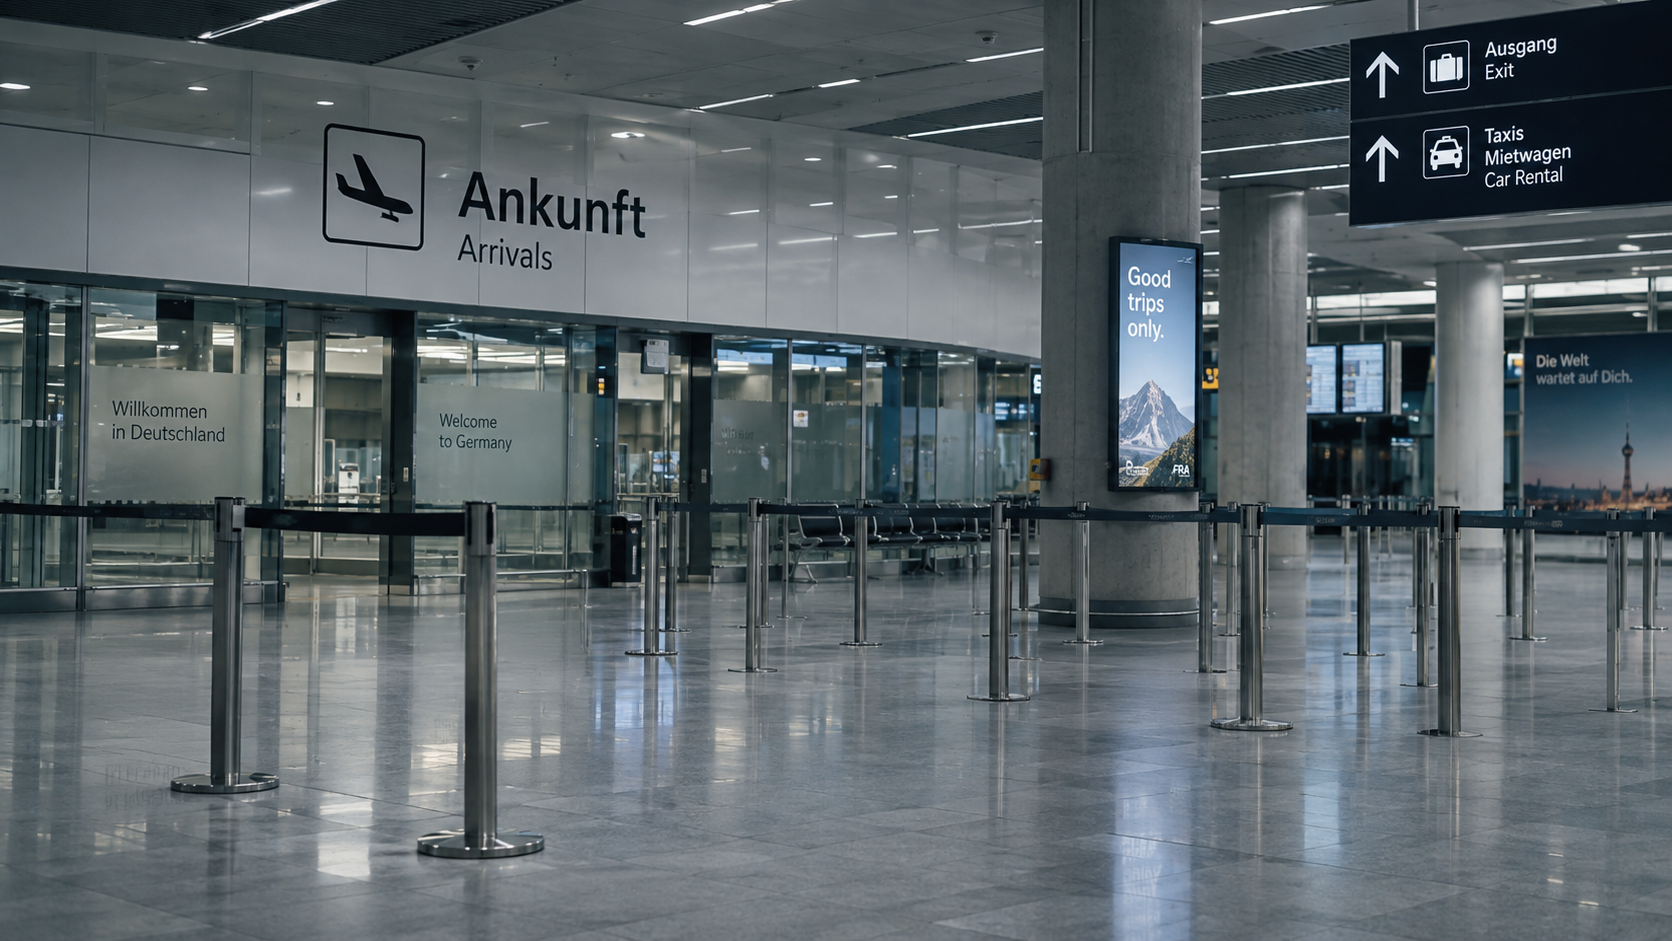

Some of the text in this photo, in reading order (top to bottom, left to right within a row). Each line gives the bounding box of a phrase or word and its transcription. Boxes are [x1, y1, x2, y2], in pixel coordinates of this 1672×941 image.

[1484, 37, 1557, 58] Ausgang
[1484, 63, 1515, 80] Exit
[1484, 126, 1524, 144] Taxis
[1484, 145, 1572, 167] Mietwagen
[1484, 166, 1563, 188] Car Rental
[458, 171, 646, 238] Ankunft
[457, 234, 553, 271] Arrivals
[1127, 266, 1171, 289] Good
[1127, 292, 1165, 316] trips
[1127, 319, 1165, 343] only.
[1536, 353, 1590, 368] Die Welt
[1536, 369, 1634, 385] wartet auf Dich.
[112, 400, 208, 419] Willkommen
[439, 412, 498, 429] Welcome
[112, 424, 226, 443] in Deutschland
[438, 434, 513, 452] to Germany
